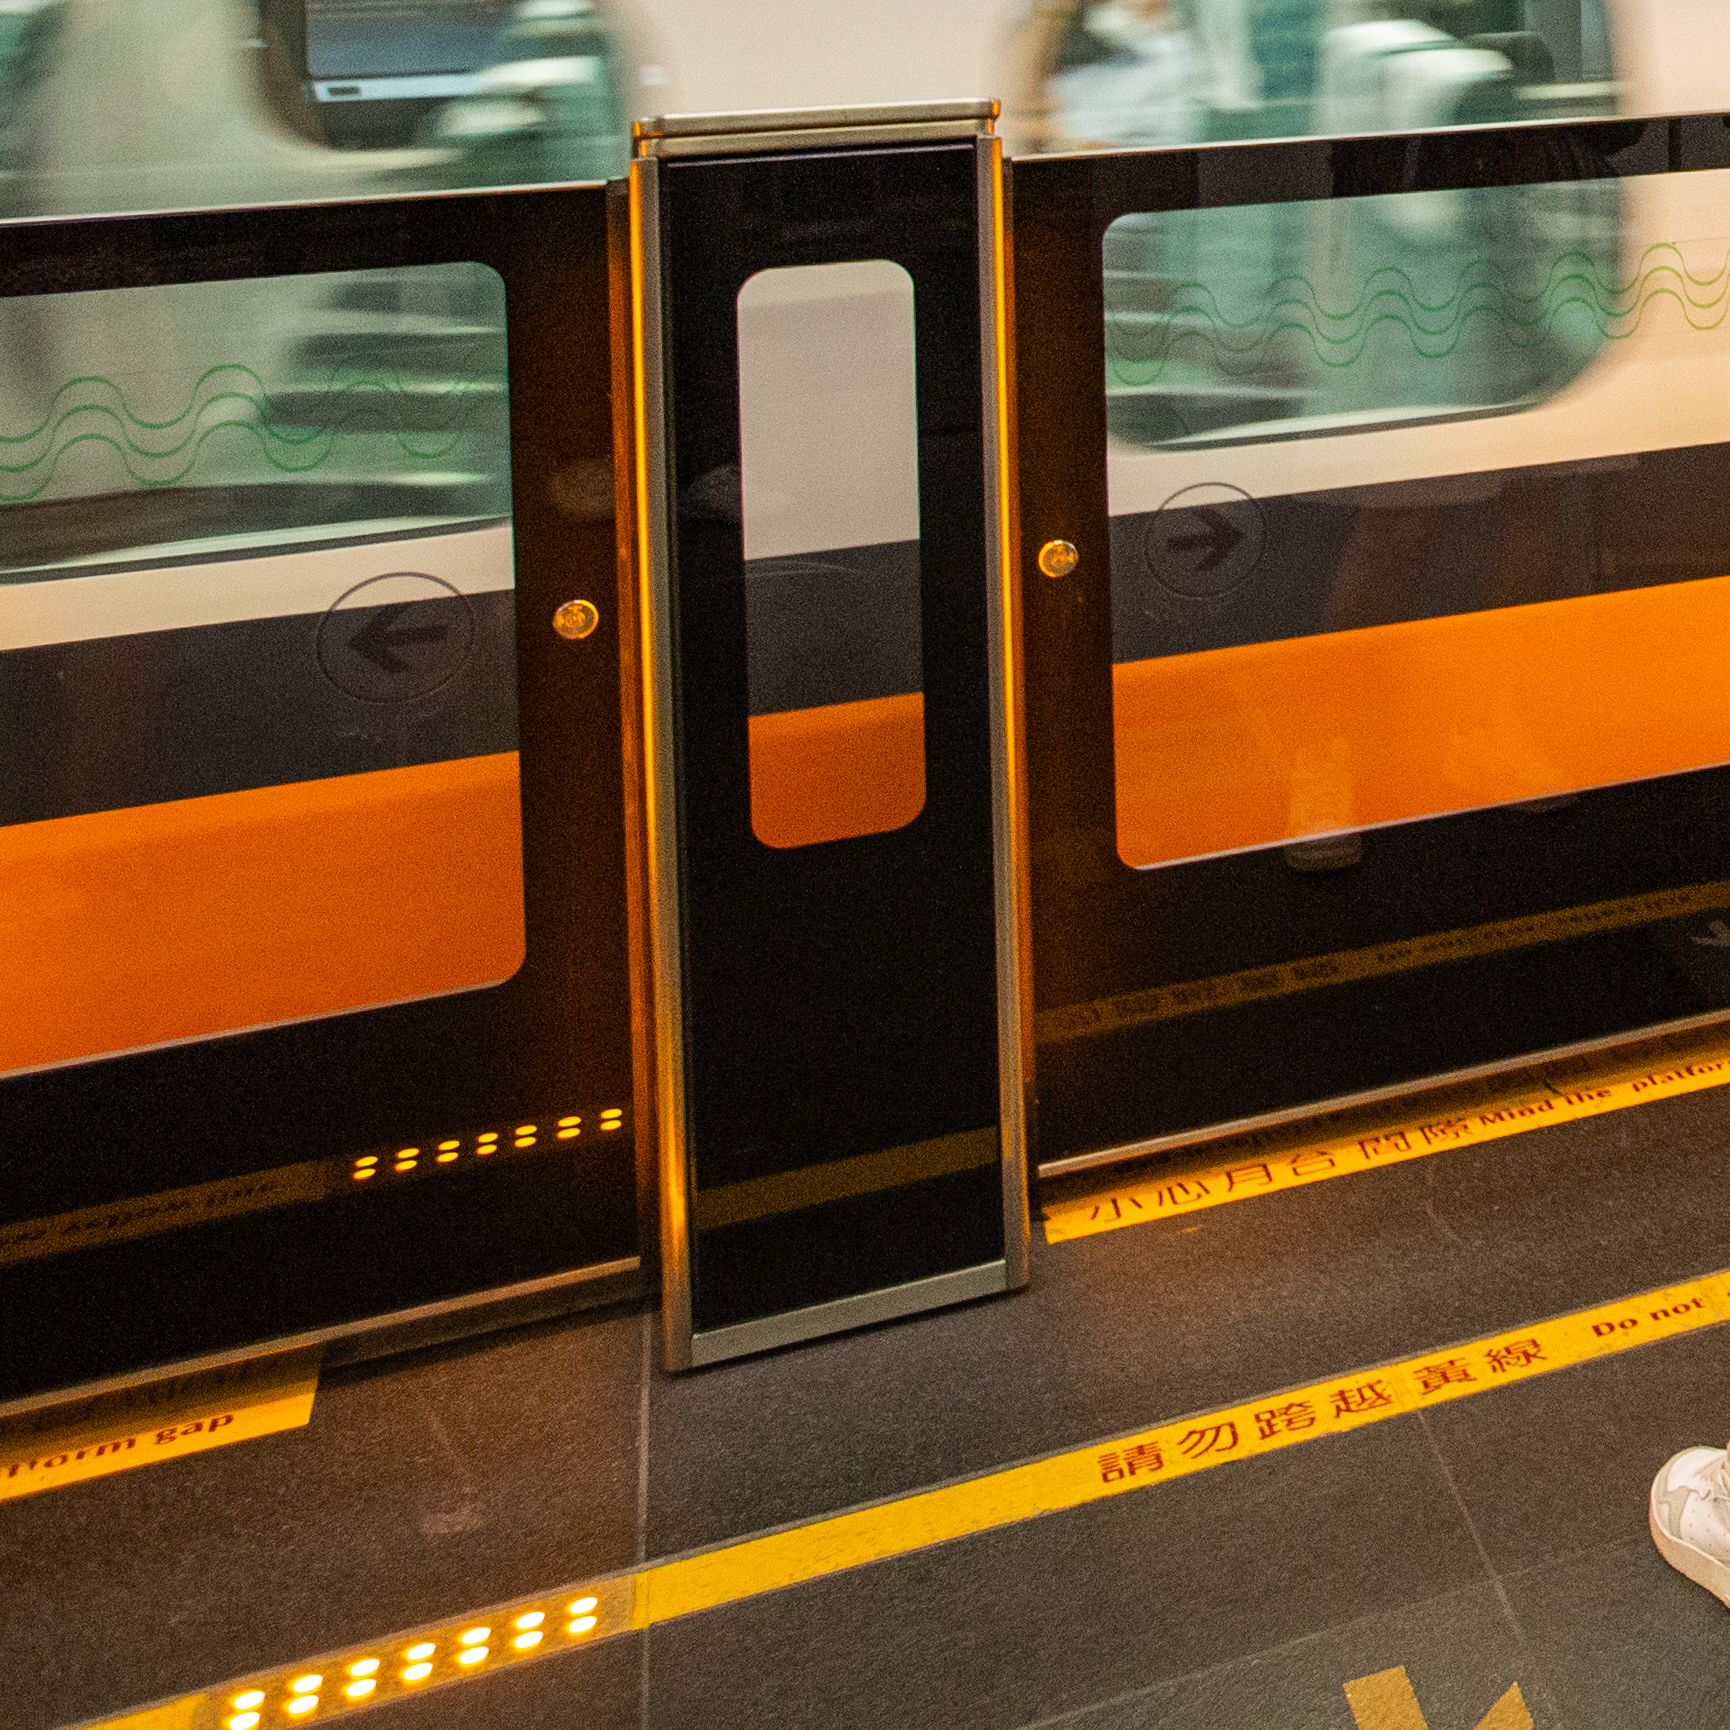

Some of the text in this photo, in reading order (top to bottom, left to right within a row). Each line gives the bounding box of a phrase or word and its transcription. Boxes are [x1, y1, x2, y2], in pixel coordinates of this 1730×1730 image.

[1479, 1099, 1554, 1127] Mind
[1566, 1088, 1612, 1106] the
[1091, 1117, 1473, 1222] 小心月台間隙
[1591, 1318, 1638, 1337] Do
[1649, 1297, 1704, 1321] not
[154, 1414, 234, 1446] gap
[1099, 1337, 1548, 1483] 請勿跨越黃線
